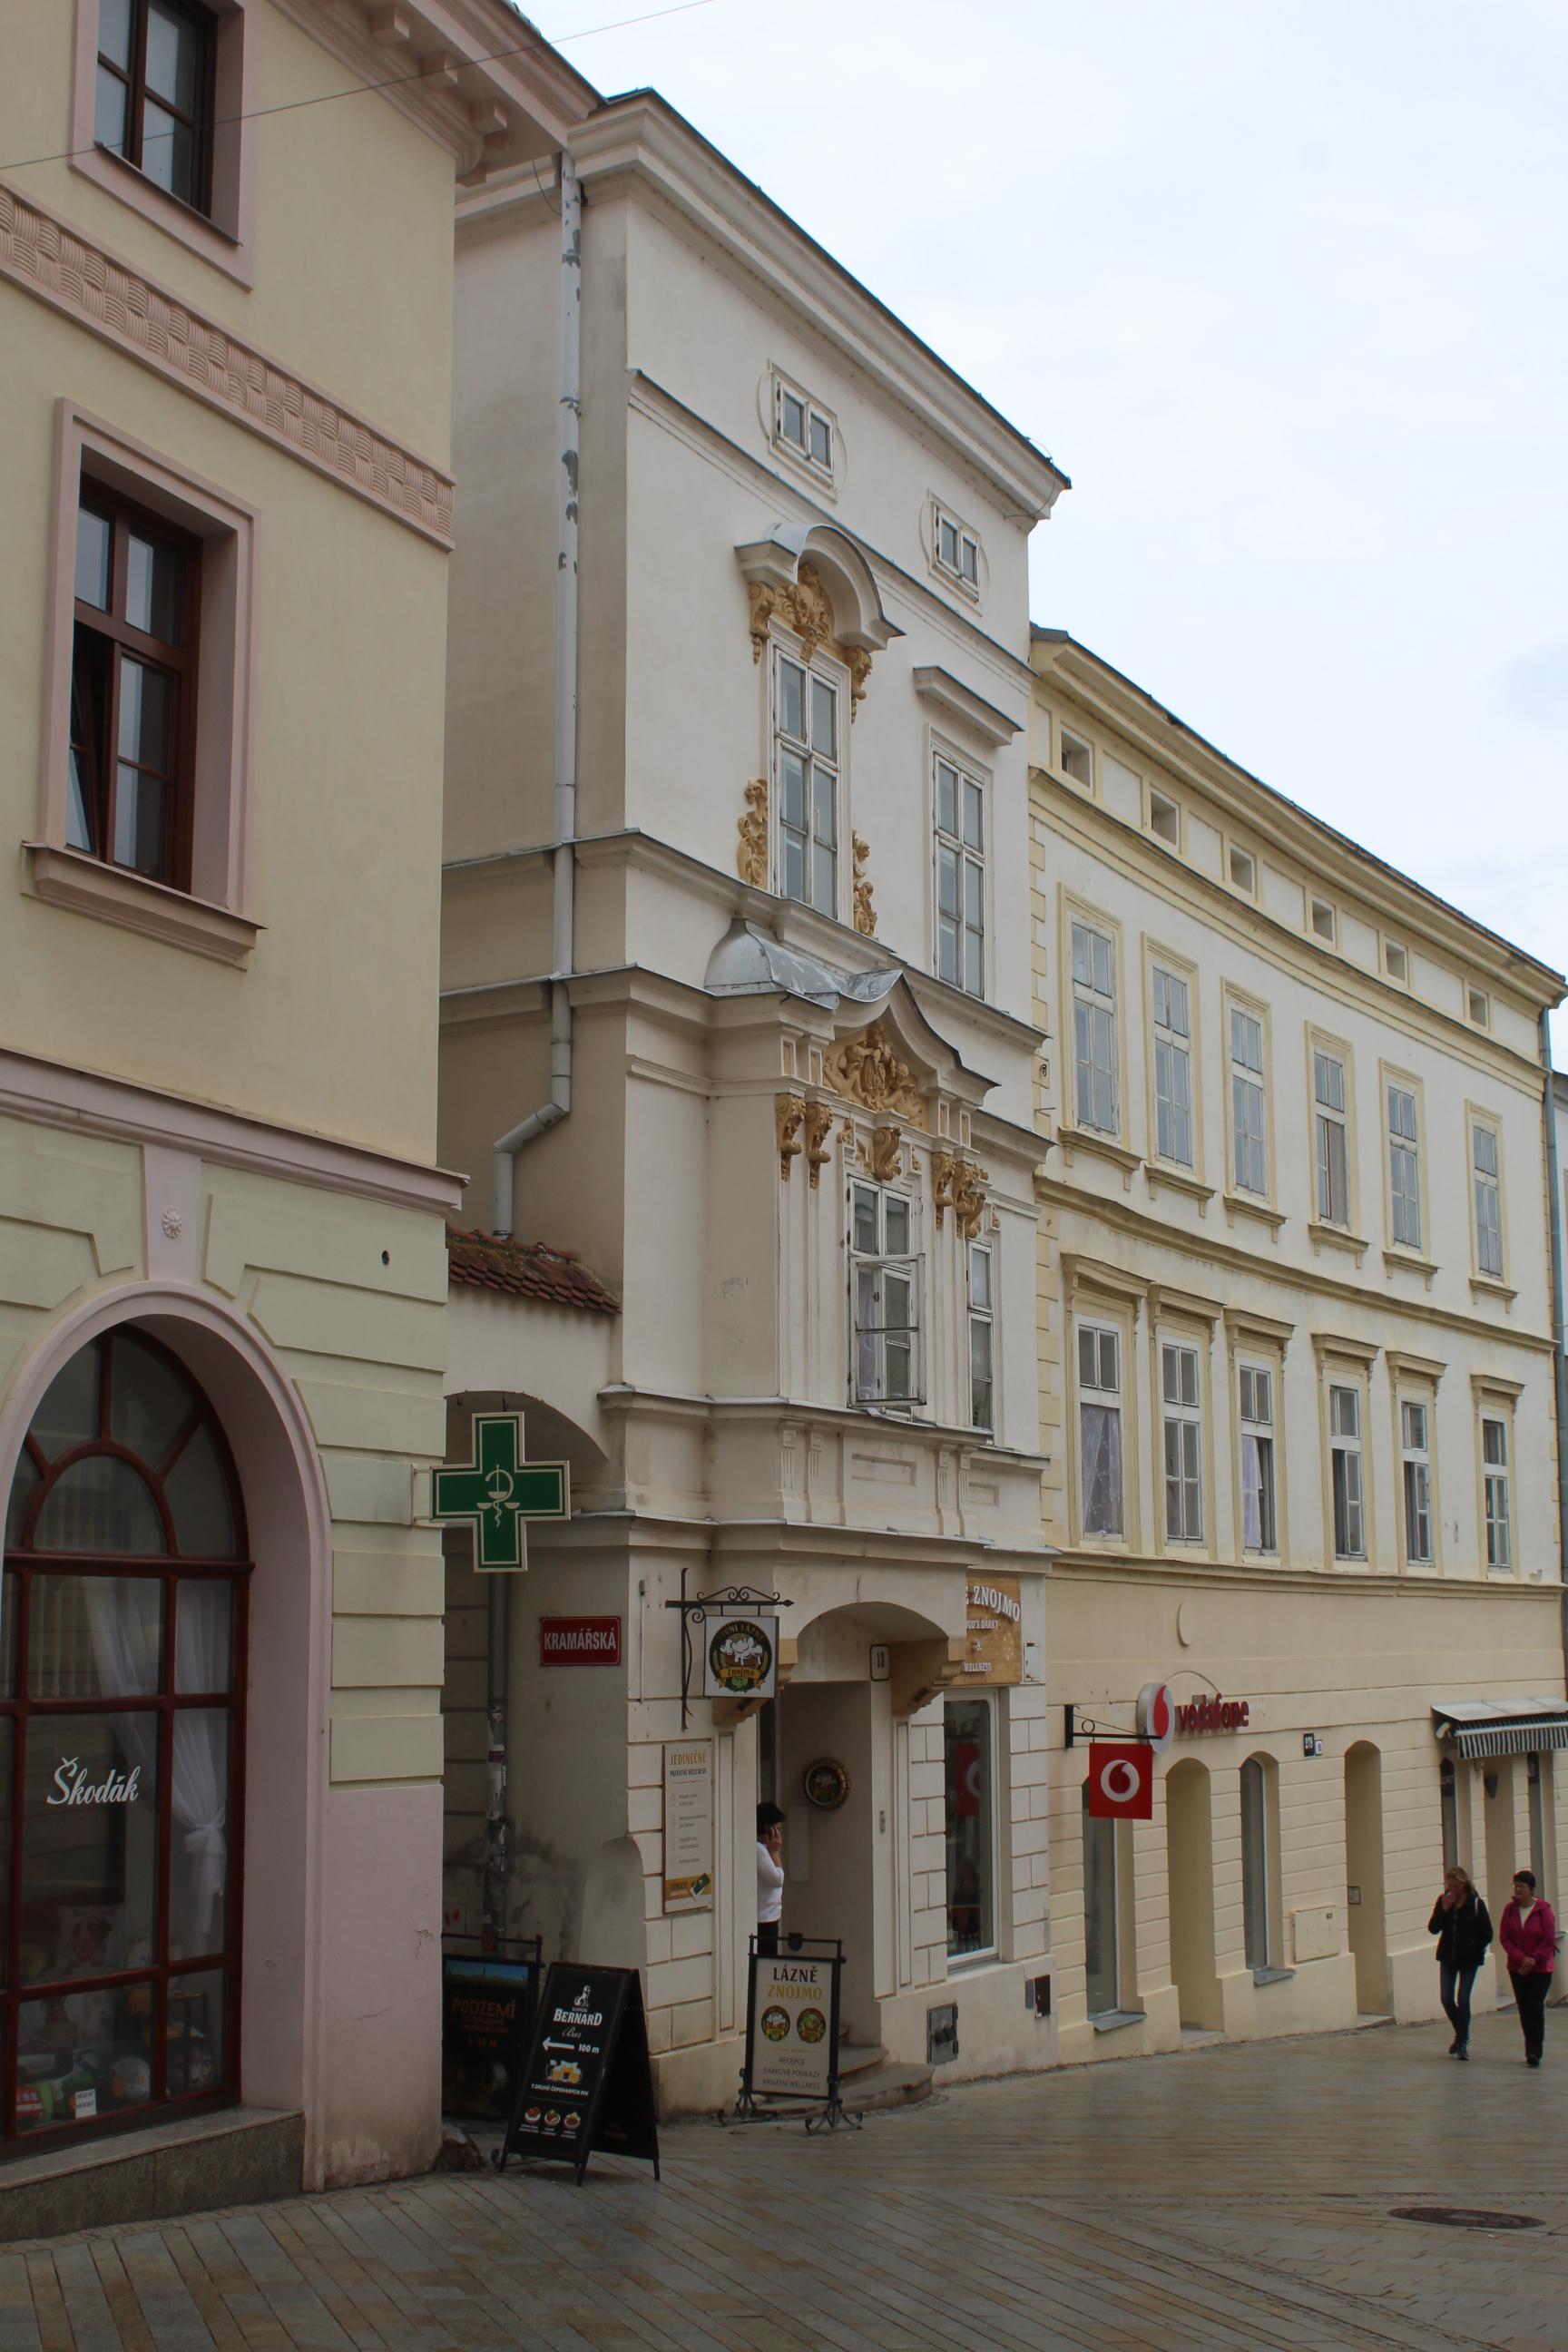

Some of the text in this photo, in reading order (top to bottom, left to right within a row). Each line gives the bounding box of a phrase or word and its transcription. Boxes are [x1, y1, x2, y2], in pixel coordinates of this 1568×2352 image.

[973, 1585, 1020, 1622] ZNOJMO
[544, 1627, 617, 1650] KRAMÁŘSKÁ
[1174, 1693, 1250, 1731] vodafone
[46, 1757, 141, 1805] Škodák
[773, 1964, 818, 1983] LÁZNĚ
[768, 1984, 823, 2000] ZNOJMO
[451, 1998, 516, 2019] PODZEMÍ
[553, 2007, 603, 2026] BERNARD
[562, 2026, 583, 2038] Bar
[578, 2043, 591, 2053] 100
[779, 2056, 805, 2066] RECEPCE
[763, 2067, 820, 2078] DÁRKOVÉ POUKAZY
[763, 2077, 820, 2090] PRIVÁTNÍ WELLNESS
